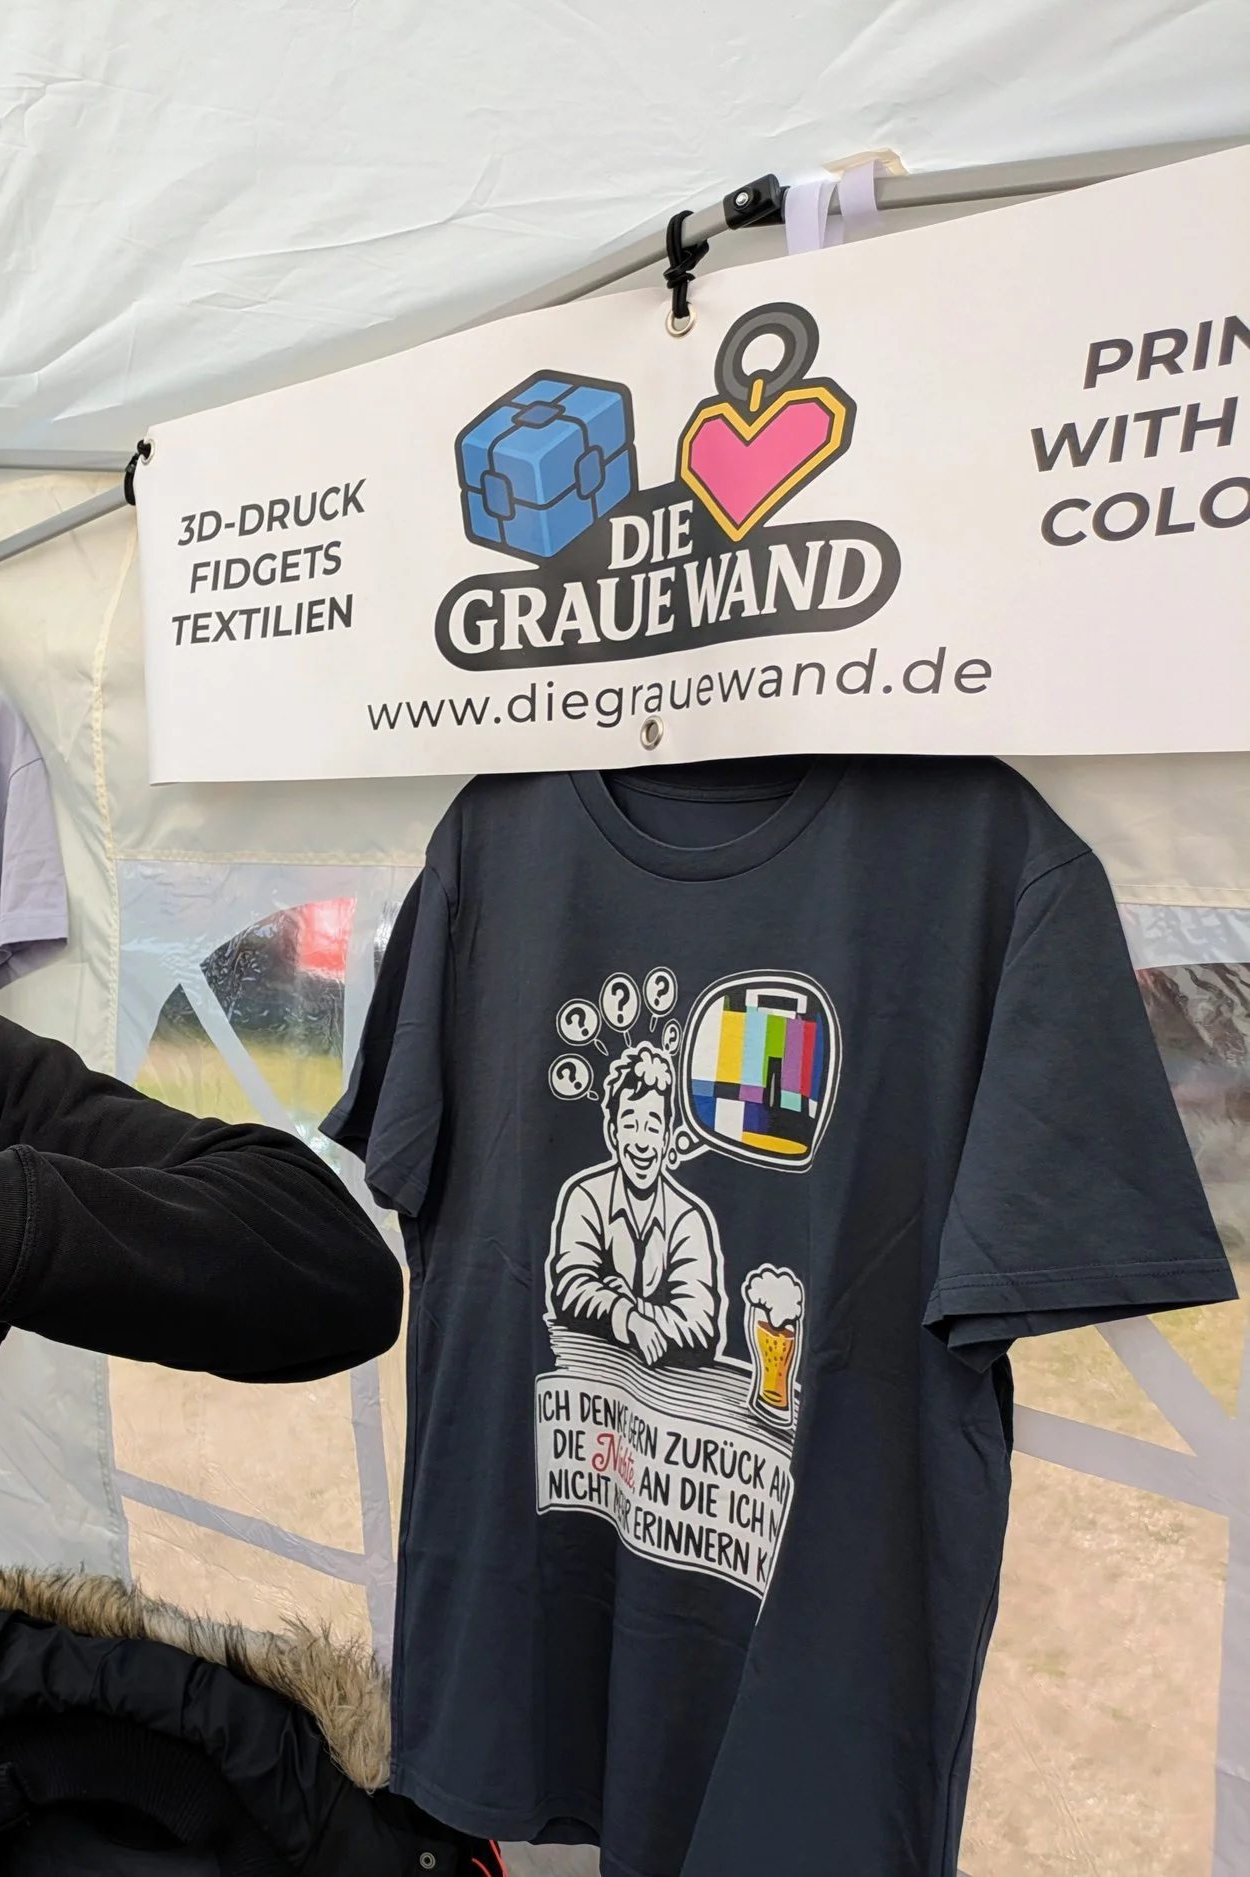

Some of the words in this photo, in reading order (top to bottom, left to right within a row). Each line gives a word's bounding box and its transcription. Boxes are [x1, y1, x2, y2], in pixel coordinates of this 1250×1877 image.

[1030, 396, 1239, 473] WITH
[177, 478, 367, 546] 3D-DRUCK
[608, 500, 693, 570] DIE
[1041, 476, 1250, 547] COLO
[190, 541, 342, 594] FIDGETS
[171, 594, 354, 646] TEXTILIEN
[367, 646, 992, 731] www.diegrauewand.de
[538, 1390, 571, 1423] ICH
[579, 1392, 628, 1439] DENKE
[664, 1431, 766, 1490] ZURÜCK
[553, 1428, 586, 1461] DIE
[639, 1466, 670, 1506] AN
[680, 1477, 720, 1518] DIE
[729, 1490, 765, 1538] ICH
[549, 1468, 611, 1508] NICHT
[634, 1506, 750, 1575] ERINNERN
